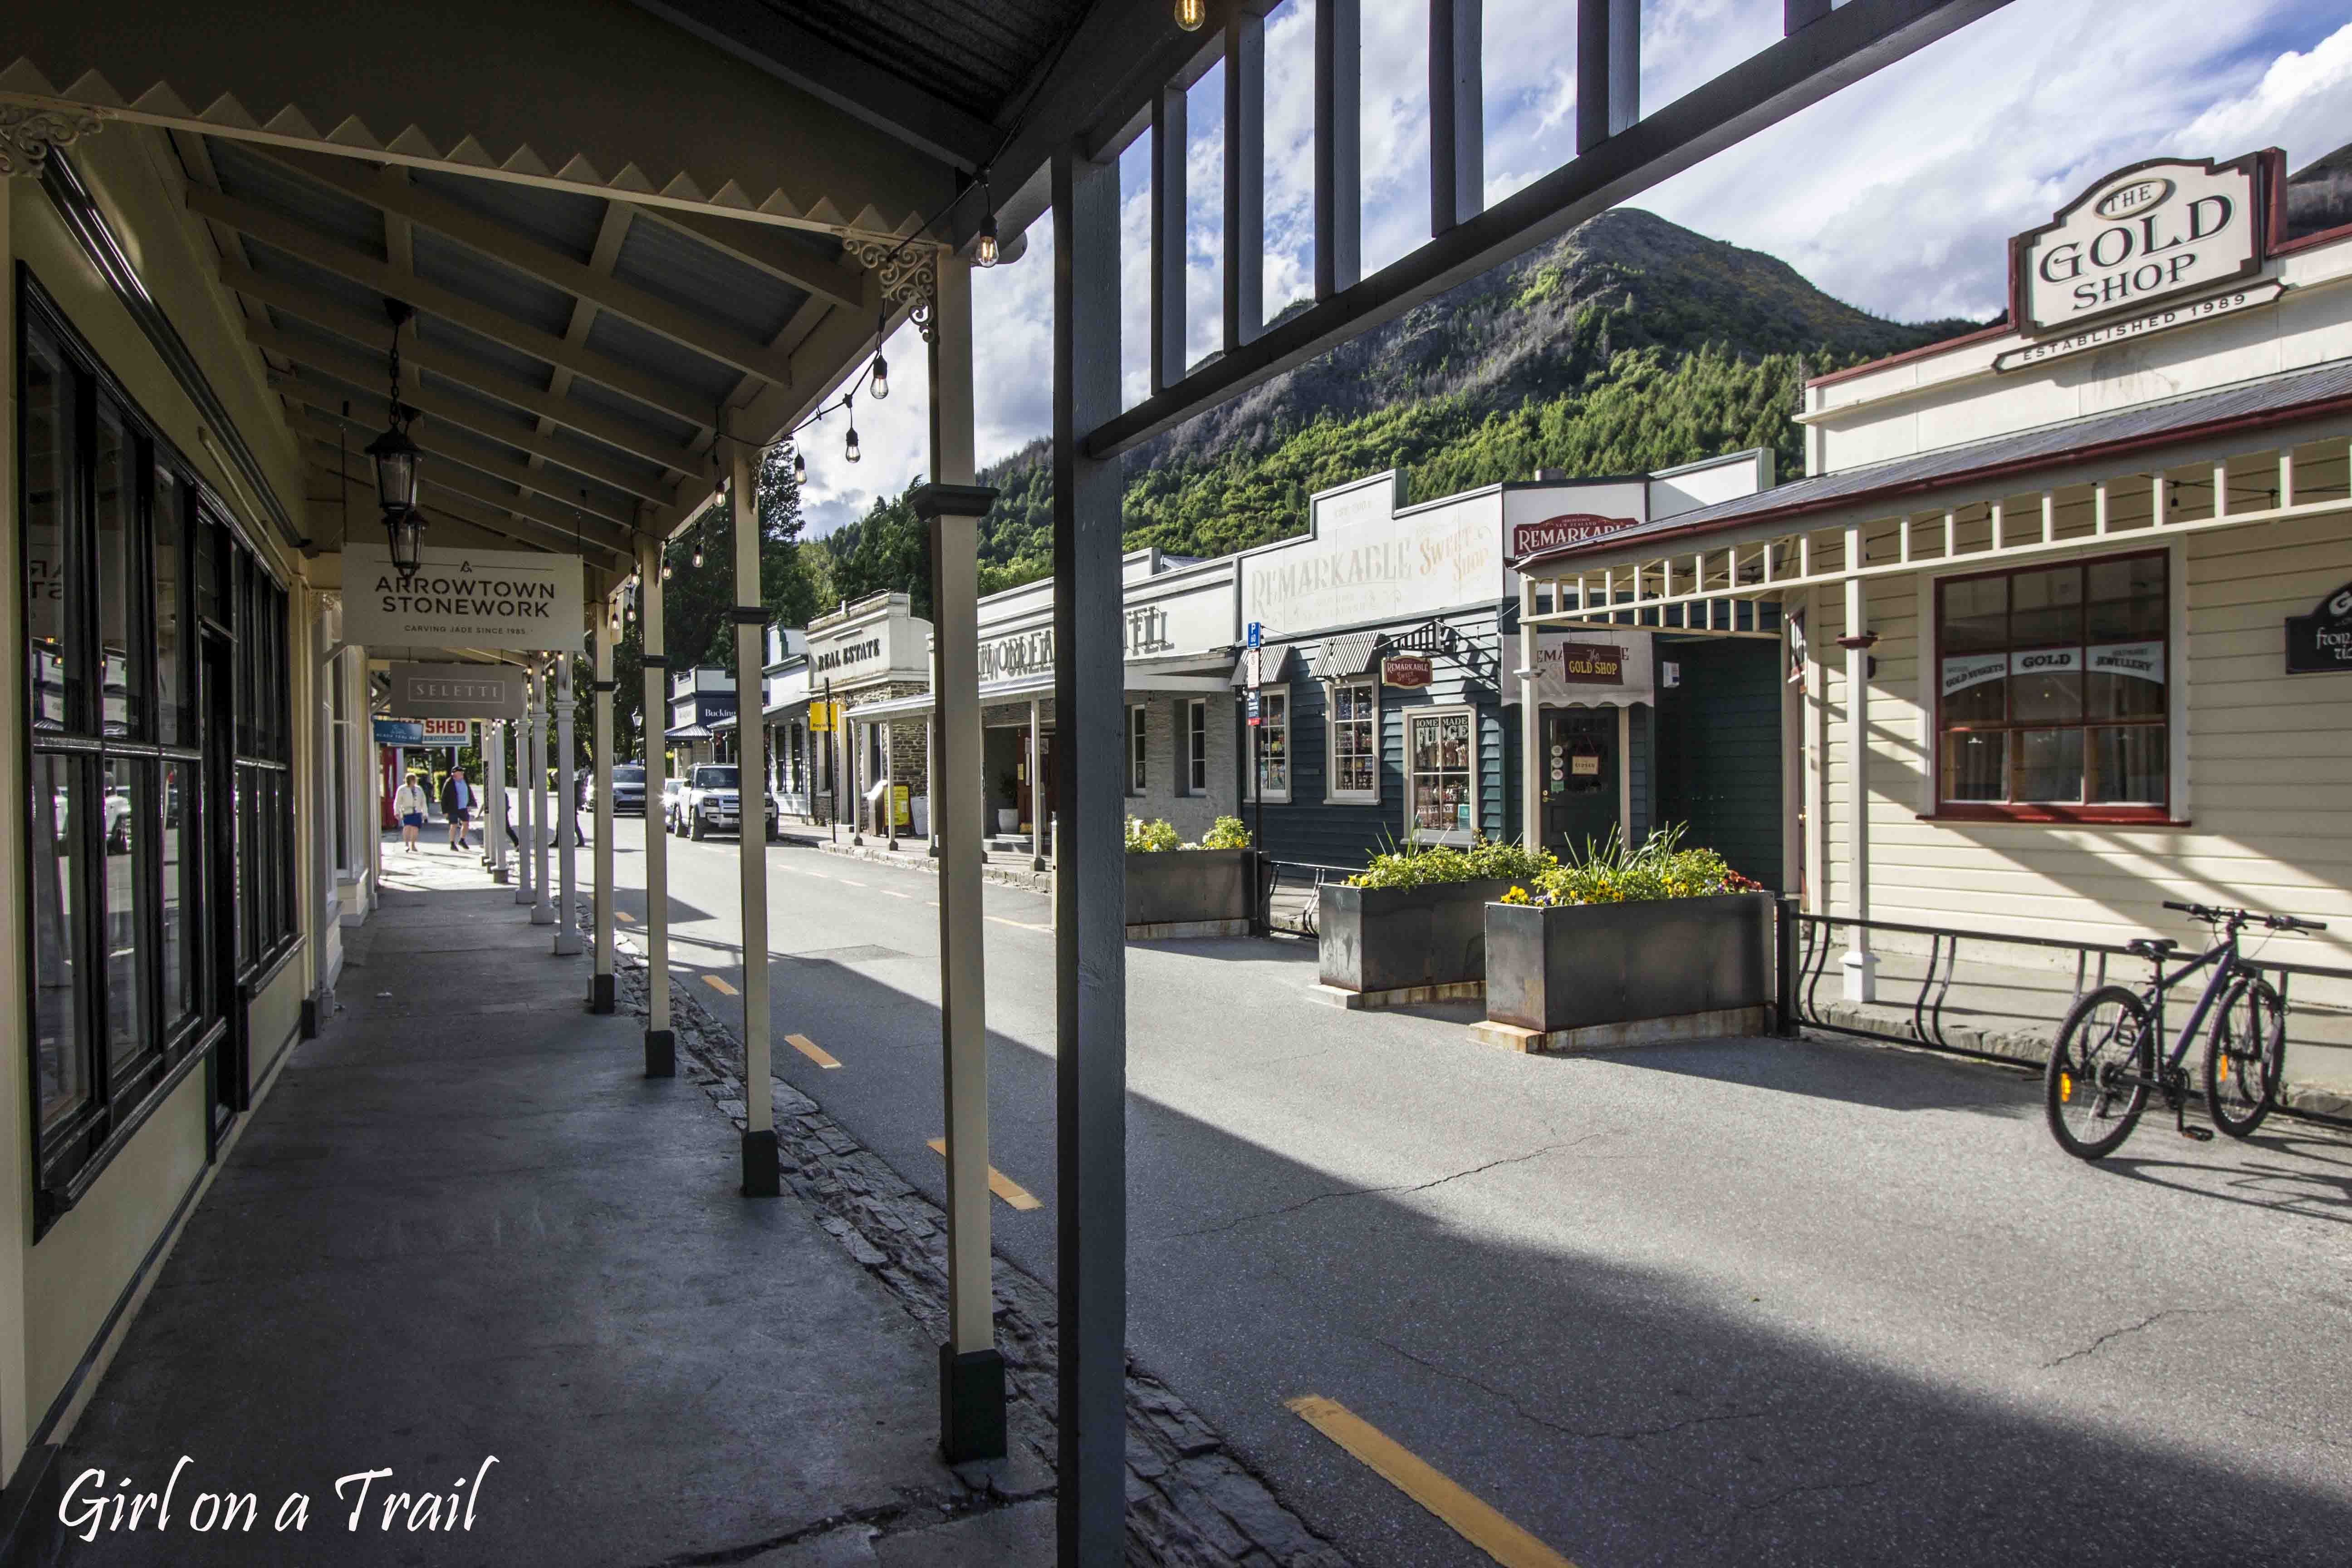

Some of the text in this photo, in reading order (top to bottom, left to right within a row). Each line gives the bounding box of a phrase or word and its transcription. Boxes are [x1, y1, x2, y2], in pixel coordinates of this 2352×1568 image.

[2107, 184, 2151, 214] THE
[2039, 194, 2232, 283] GOLD
[2071, 253, 2196, 311] SHOP
[2023, 294, 2245, 361] ESTABLISHED 1989
[1518, 524, 1634, 553] REMARKAB
[1252, 537, 1412, 619] REMARKABLE
[375, 576, 554, 599] ARROWTOWN
[382, 596, 549, 618] STONEWORK
[405, 625, 446, 633] CARVING
[1251, 623, 1256, 634] P
[1251, 634, 1256, 642] 60
[818, 638, 880, 671] REAL ESTATE
[999, 629, 1055, 671] ORLEA
[1387, 663, 1429, 673] REMARKABLE
[1568, 660, 1592, 674] GOLD
[1595, 662, 1617, 675] SHOP
[2022, 653, 2071, 667] GOLD
[2095, 657, 2153, 671] JEWELLERY
[1946, 673, 1967, 687] GOLD
[416, 683, 498, 697] SELETTI
[425, 720, 466, 734] SHED
